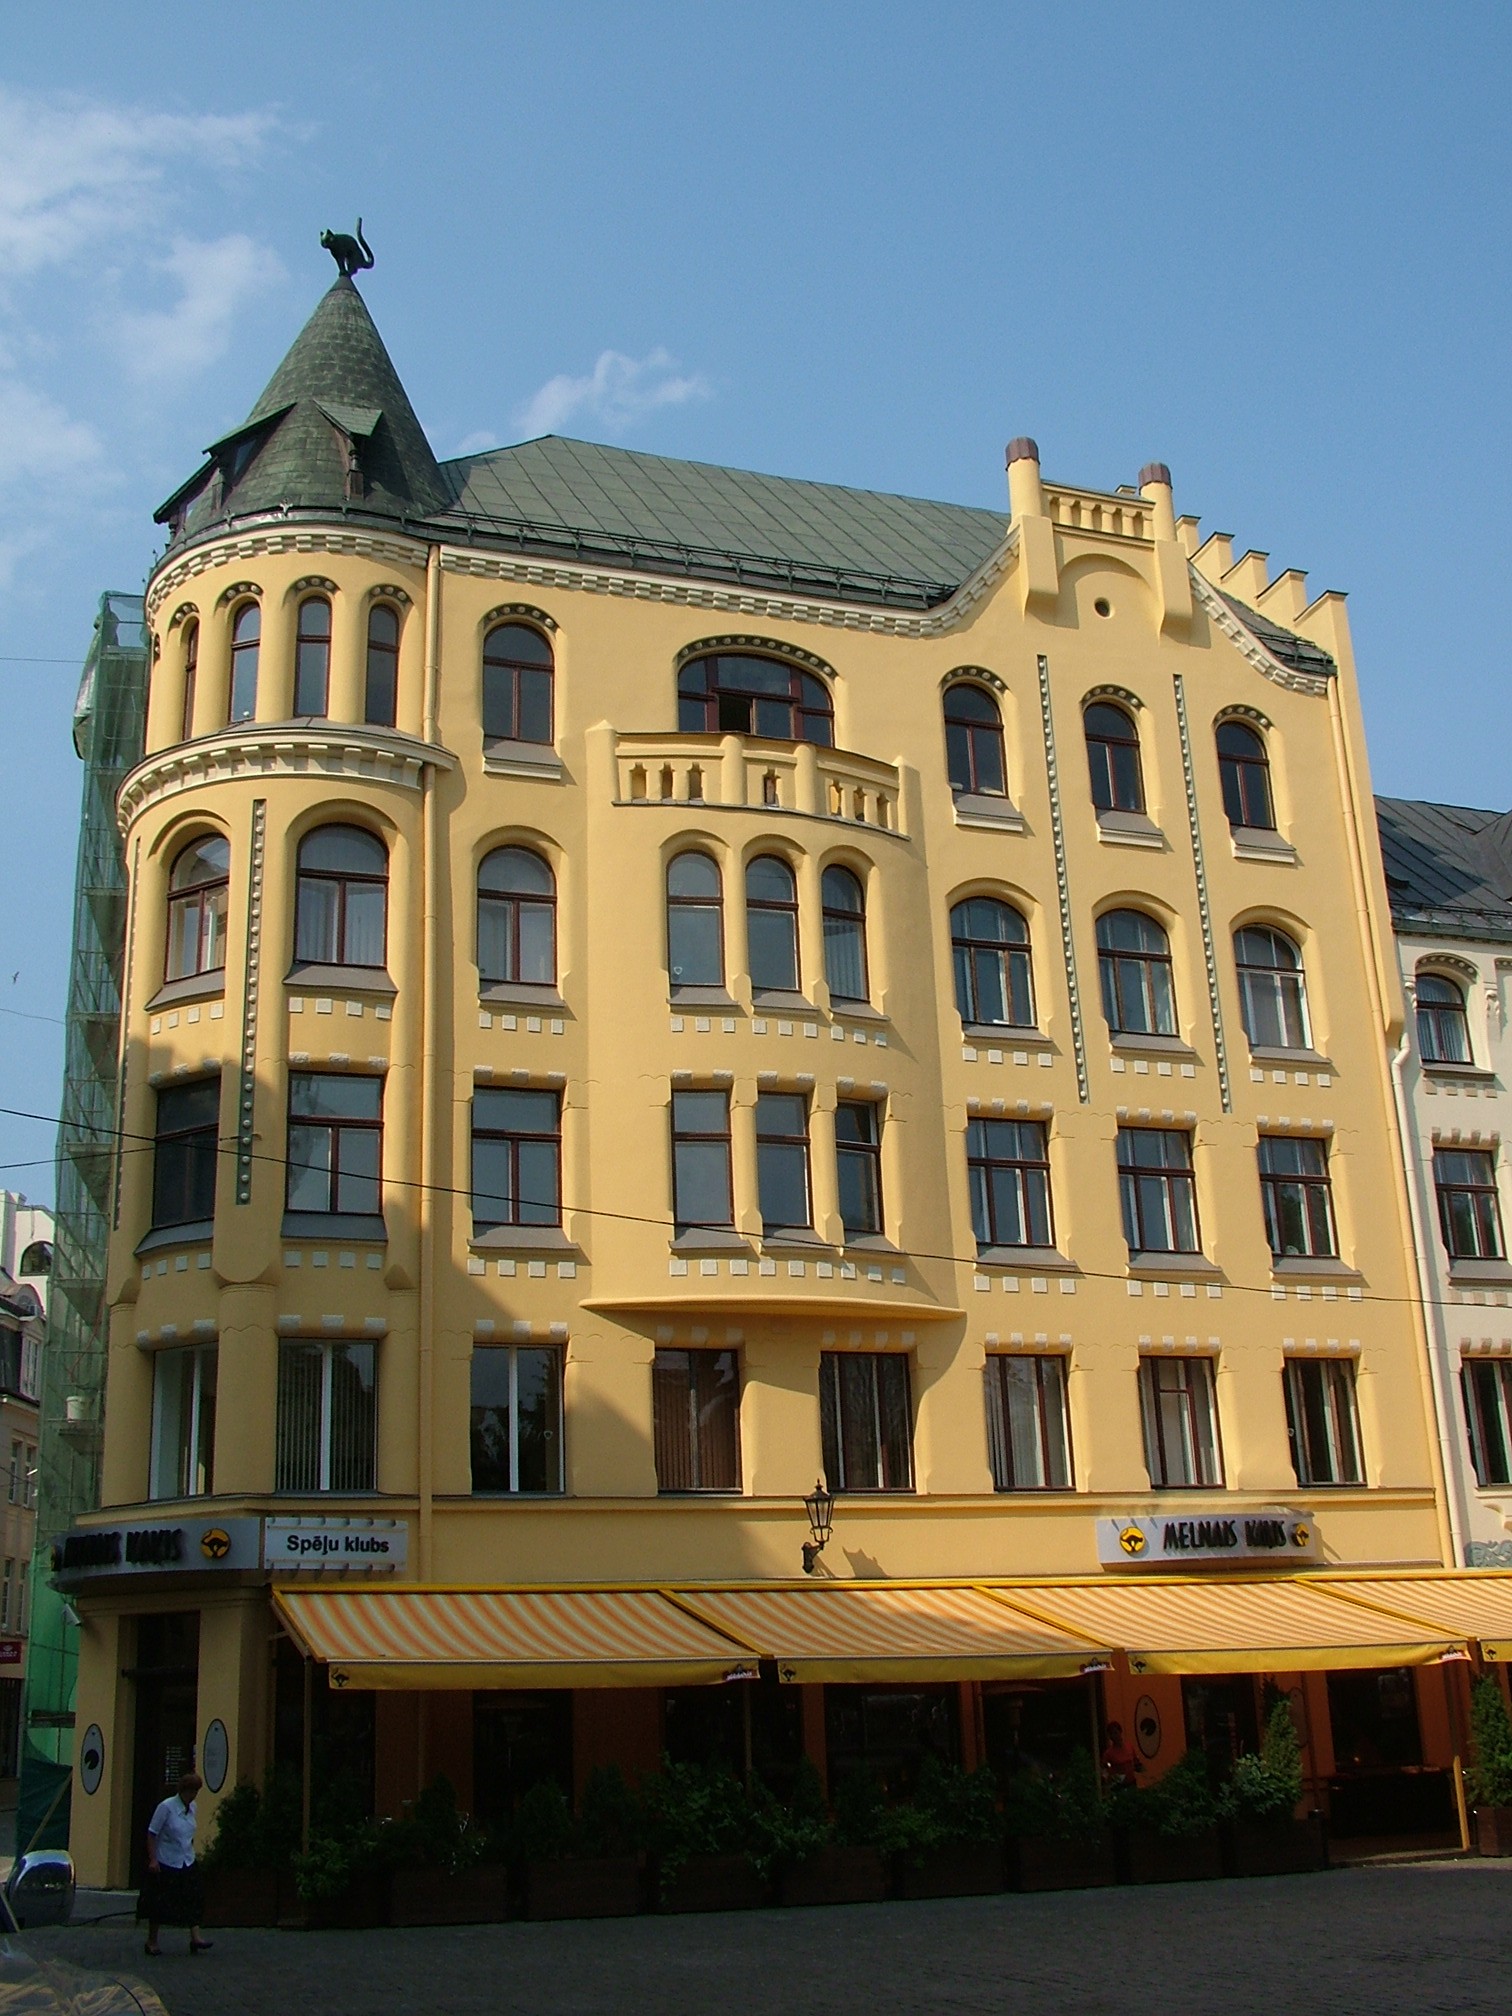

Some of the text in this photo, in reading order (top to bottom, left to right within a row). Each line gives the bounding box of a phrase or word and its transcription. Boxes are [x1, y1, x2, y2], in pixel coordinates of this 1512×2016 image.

[287, 1535, 389, 1555] Spēļu klubs
[1163, 1520, 1238, 1549] MELNAIS
